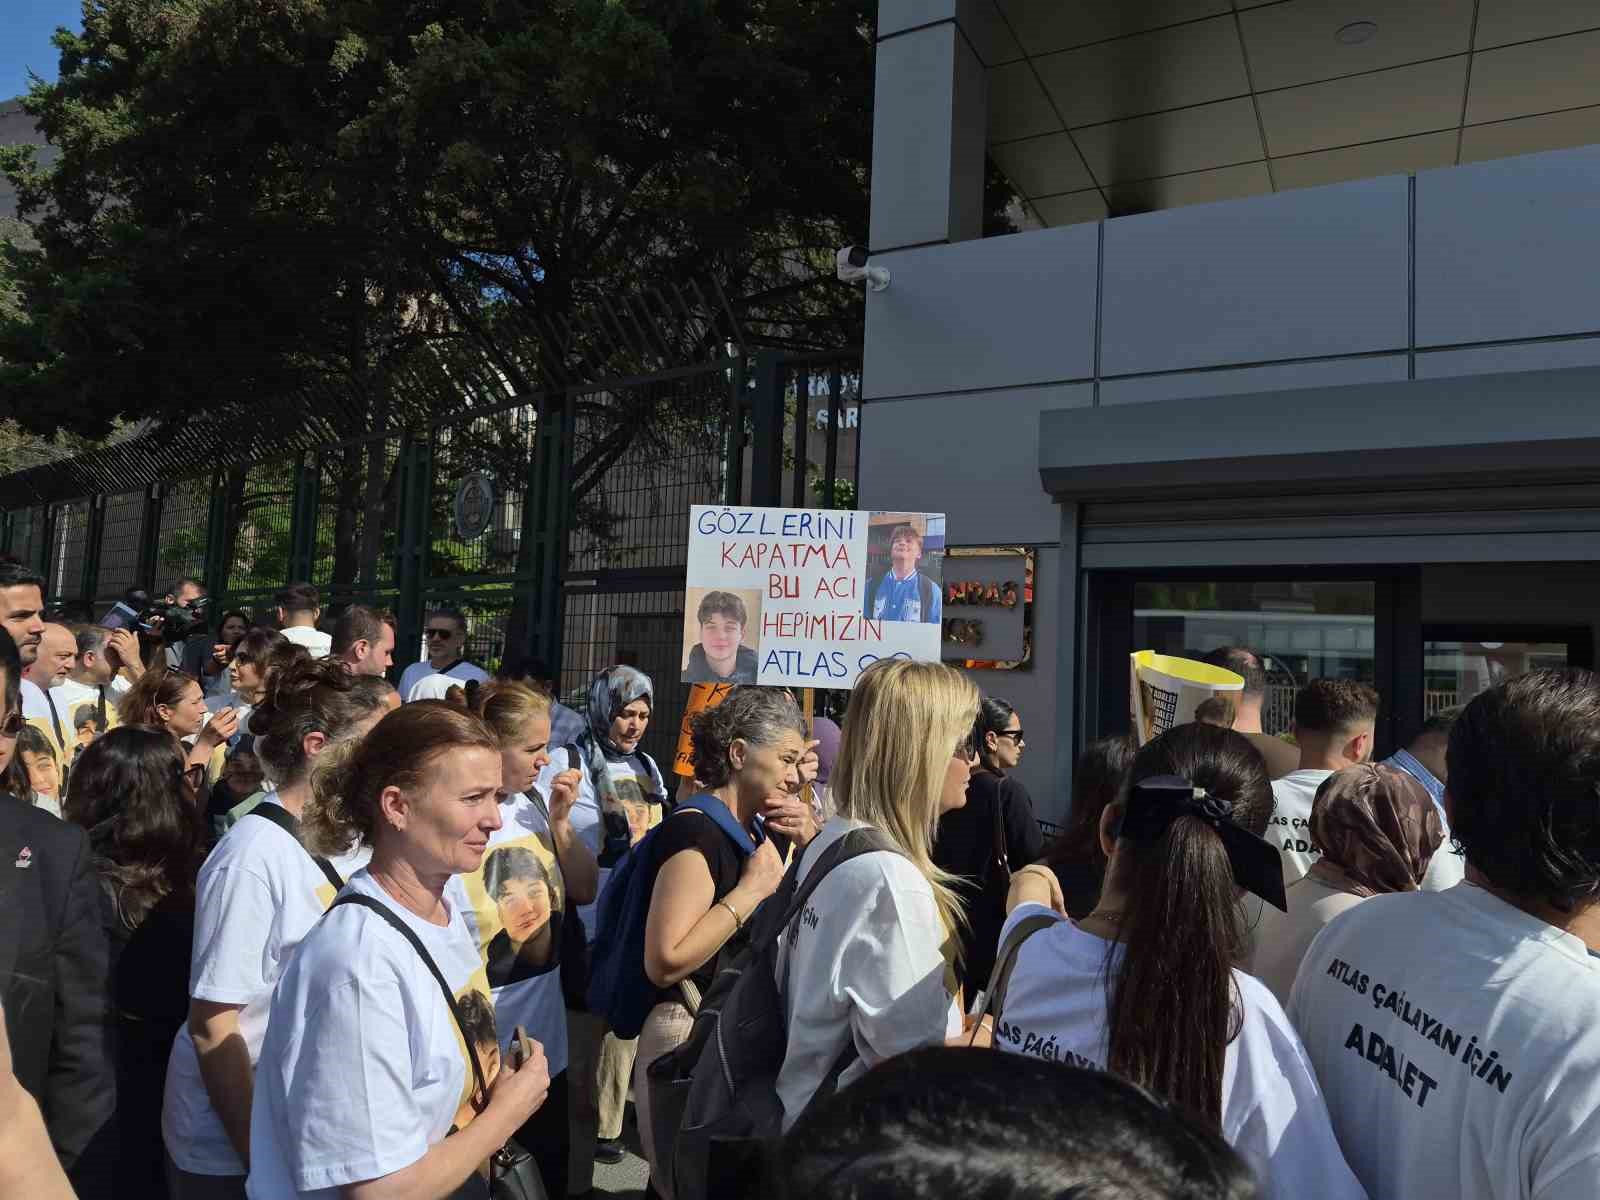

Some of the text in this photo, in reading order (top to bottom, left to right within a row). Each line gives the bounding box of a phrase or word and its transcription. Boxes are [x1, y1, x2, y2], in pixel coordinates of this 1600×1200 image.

[698, 508, 854, 540] GÖZLERİNİ
[721, 541, 851, 569] KAPATMA
[769, 574, 856, 599] BU ACI
[763, 610, 882, 641] HEPİMİZİN
[762, 649, 848, 678] ATLAS
[1327, 958, 1369, 994] ATLAS
